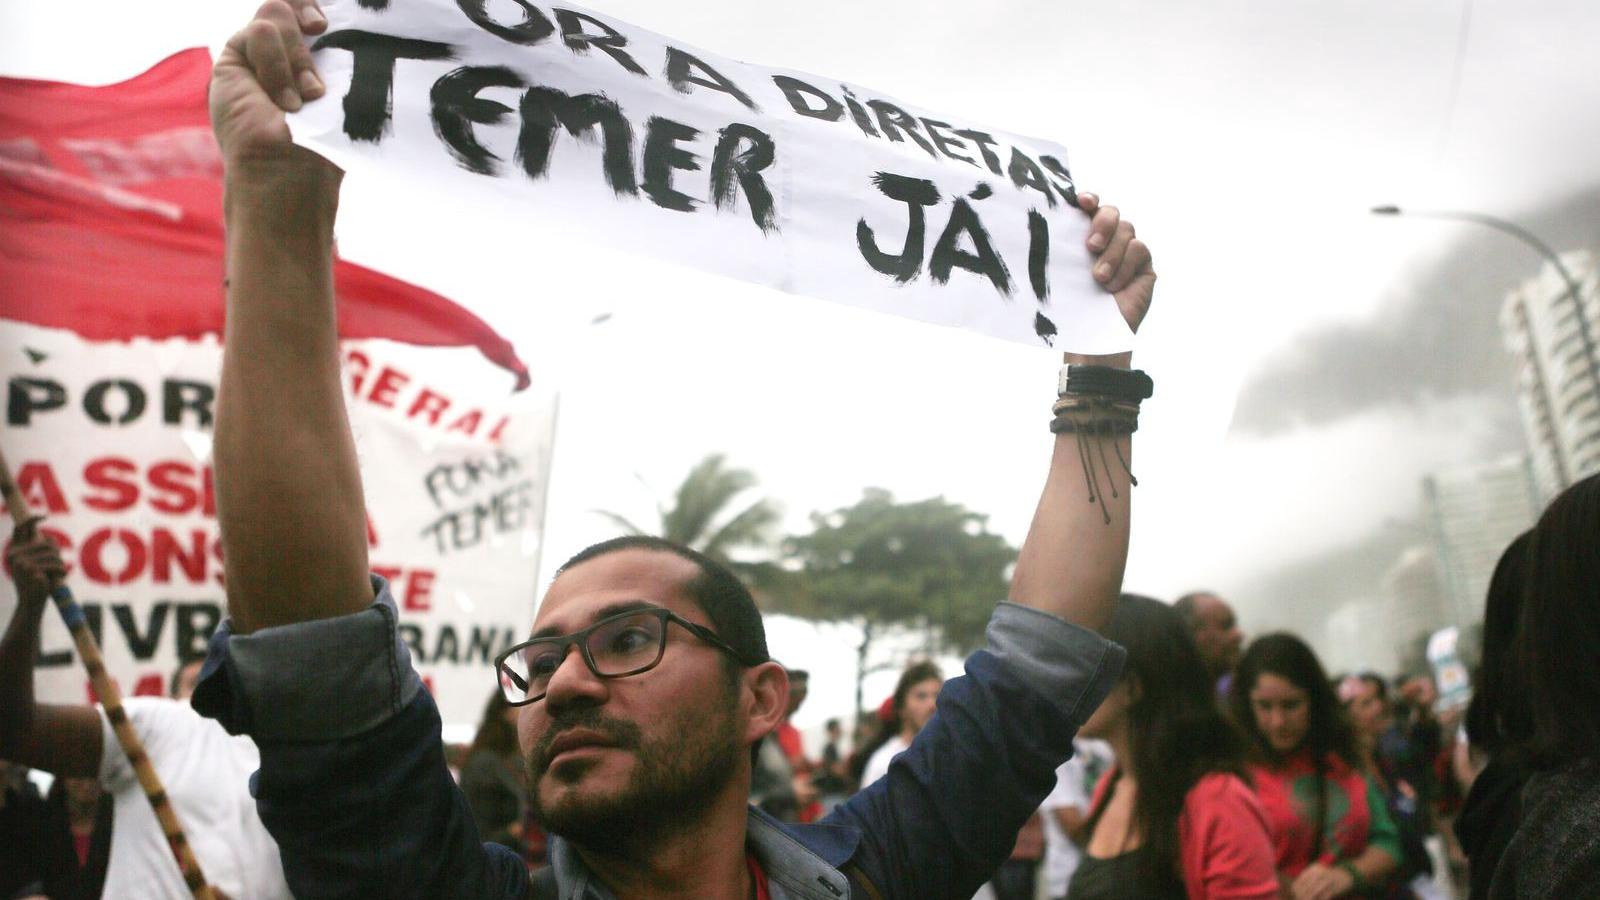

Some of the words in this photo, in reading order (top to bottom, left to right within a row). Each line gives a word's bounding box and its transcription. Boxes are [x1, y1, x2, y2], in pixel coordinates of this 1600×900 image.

[311, 29, 780, 237] TEMER
[356, 0, 761, 113] ORA
[855, 170, 1058, 348] JÁ!
